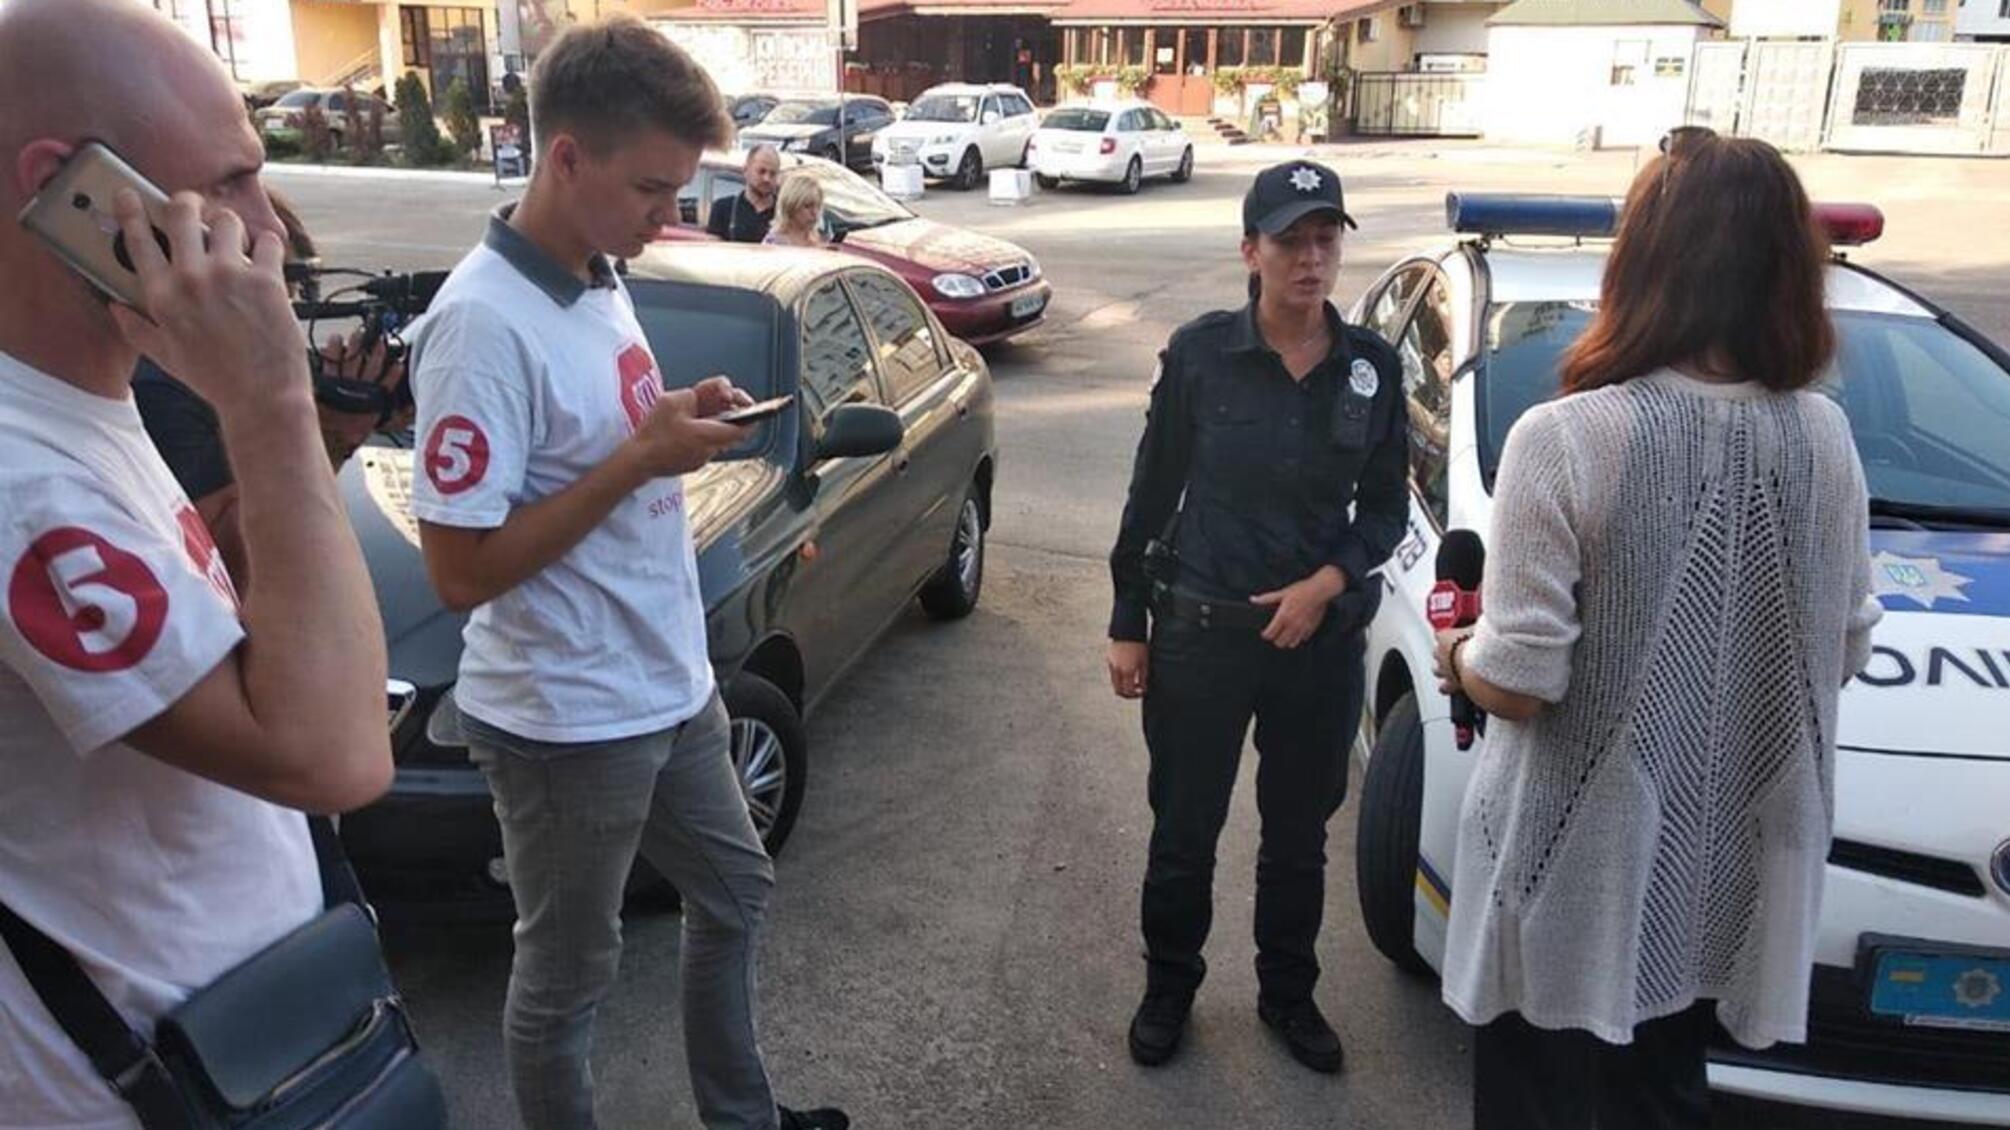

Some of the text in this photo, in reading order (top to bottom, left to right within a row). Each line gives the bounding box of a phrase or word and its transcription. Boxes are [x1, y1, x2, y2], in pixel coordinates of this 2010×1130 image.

[435, 427, 475, 482] 5
[46, 543, 138, 654] 5
[1841, 644, 2010, 689] ОЛІ
